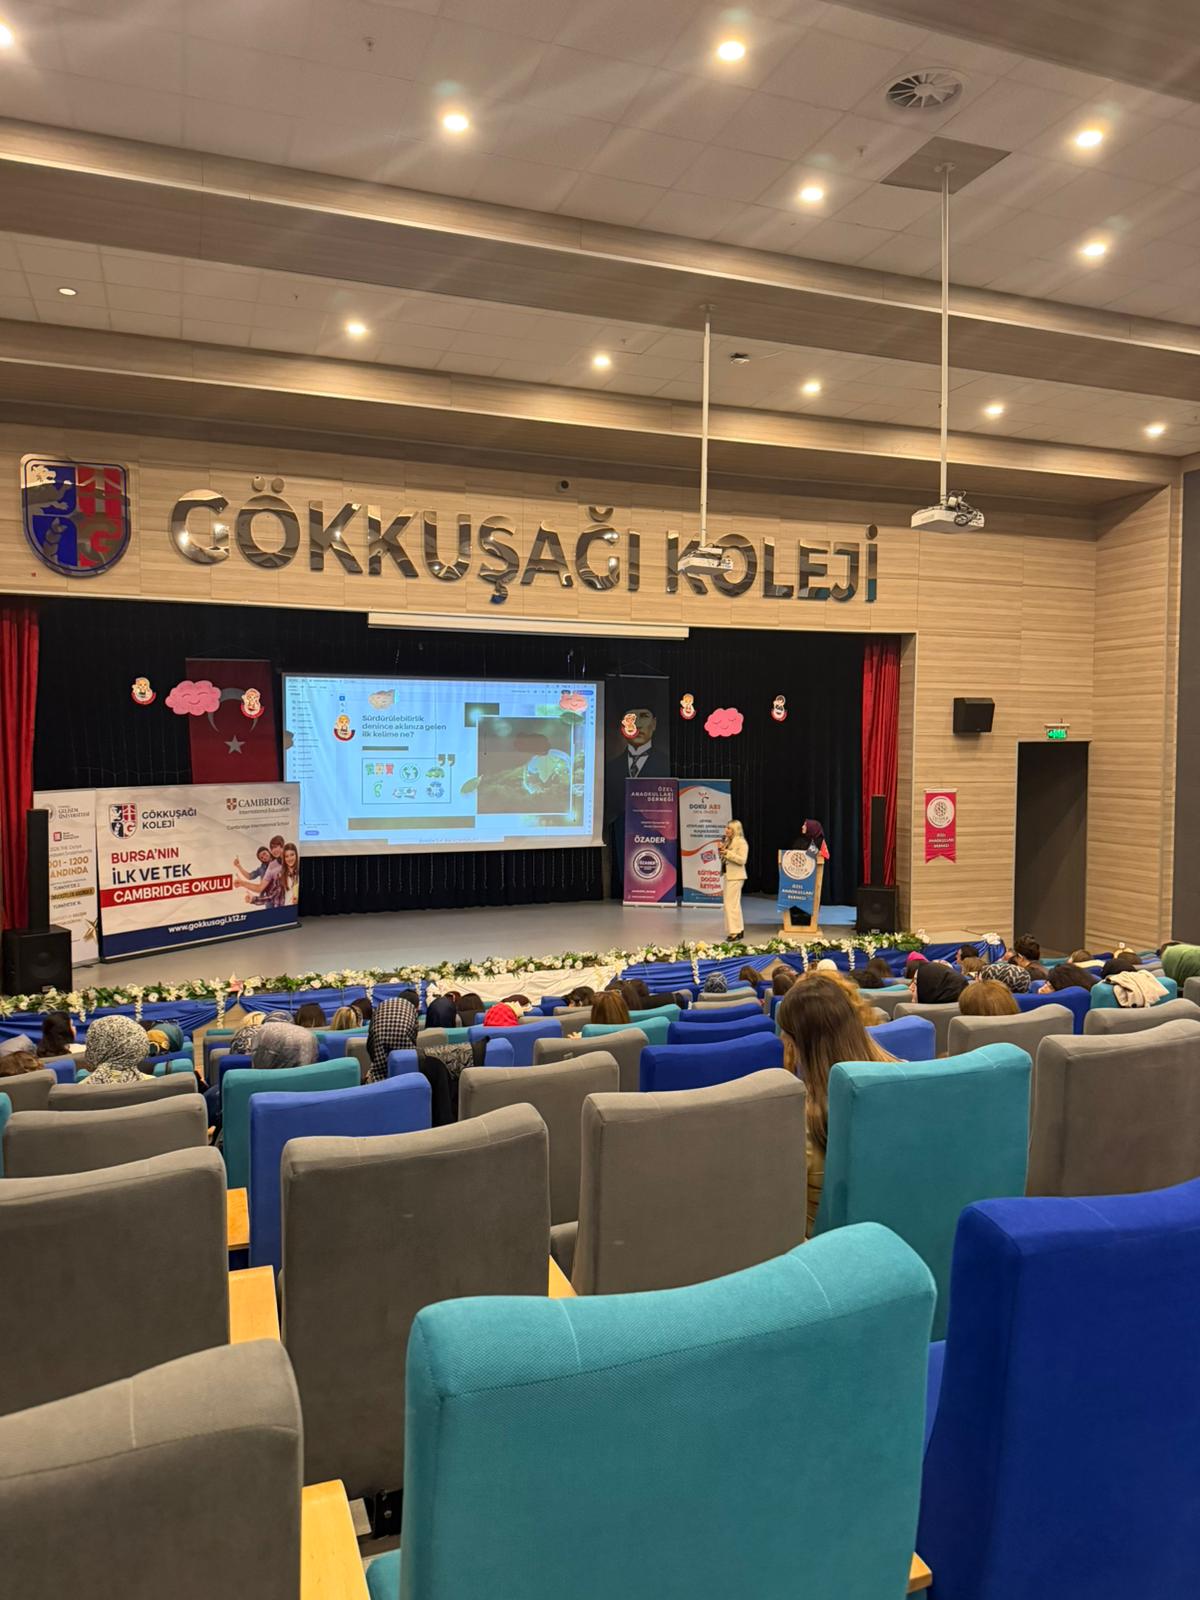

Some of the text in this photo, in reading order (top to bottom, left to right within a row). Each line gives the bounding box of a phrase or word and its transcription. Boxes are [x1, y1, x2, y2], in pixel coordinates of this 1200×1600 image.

[170, 475, 878, 604] GÖKKUŞAĞI KOLEJİ
[425, 723, 447, 731] gelen
[238, 797, 291, 808] CAMBRIDGE
[141, 807, 197, 819] GÖKKUŞAĞI
[142, 819, 175, 830] KOLEJİ
[634, 834, 666, 844] ÖZADER
[69, 855, 89, 866] 1200
[111, 847, 179, 864] BURSA'NIN
[49, 866, 89, 878] ANDINDA
[112, 863, 192, 885] İLK VE TEK
[113, 882, 190, 903] CAMBRIDGE
[191, 877, 231, 893] OKULU
[168, 914, 247, 933] www.gokkusagi.k12.tr
